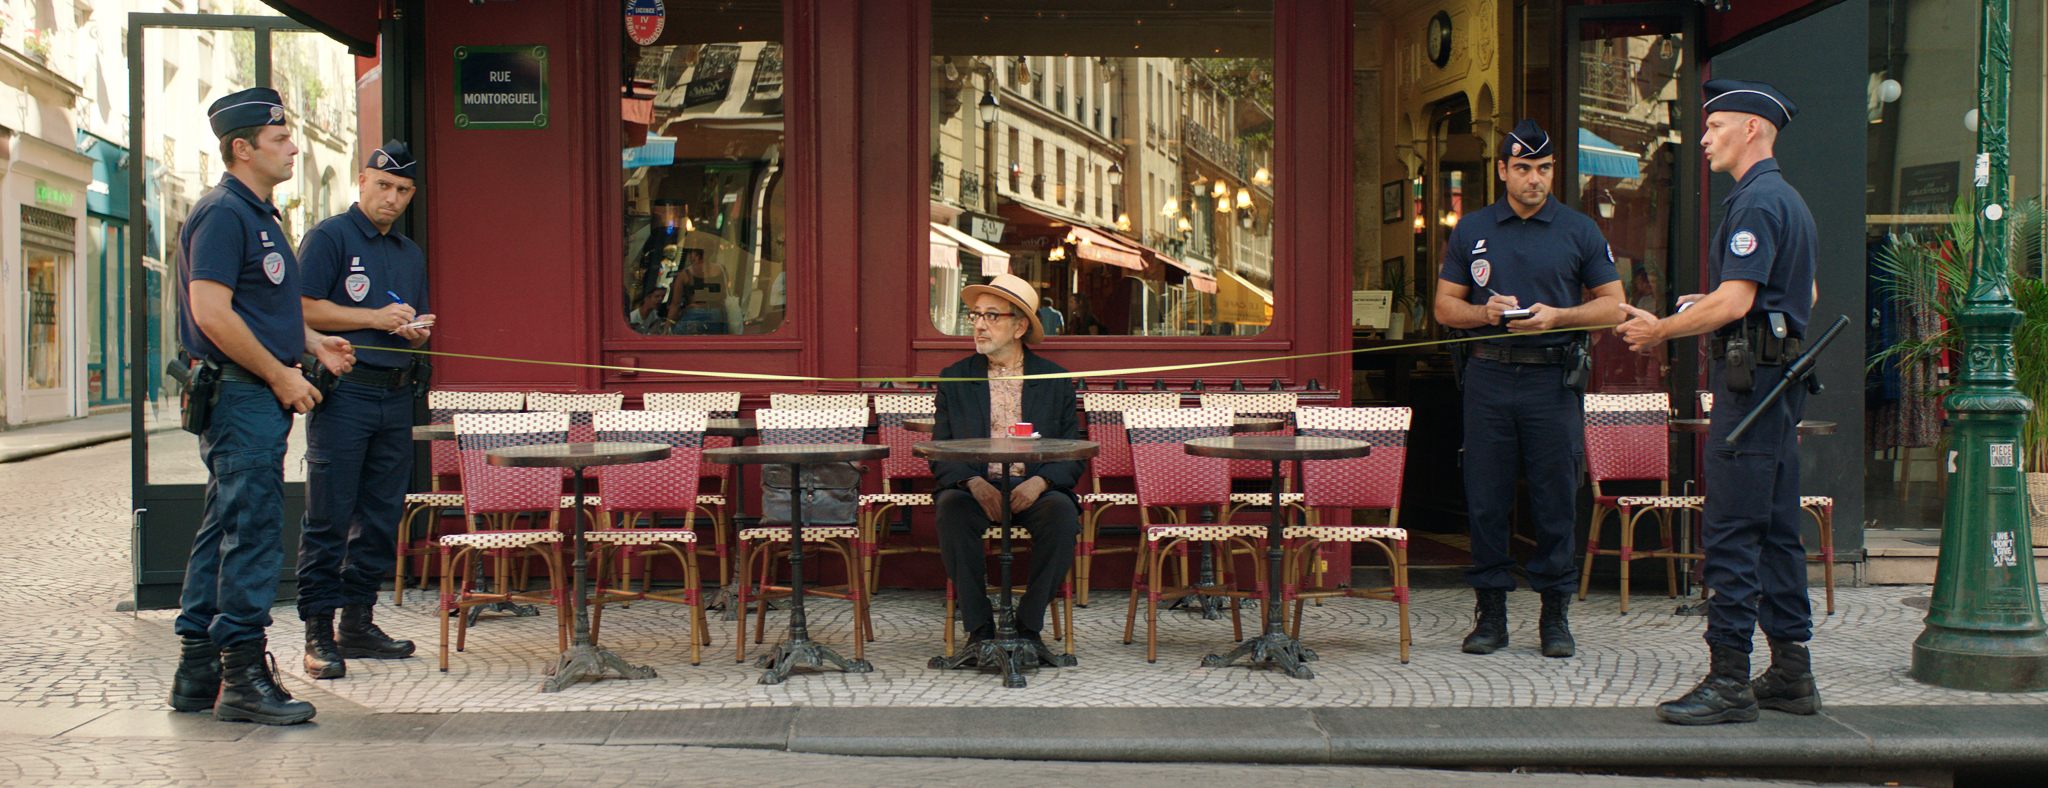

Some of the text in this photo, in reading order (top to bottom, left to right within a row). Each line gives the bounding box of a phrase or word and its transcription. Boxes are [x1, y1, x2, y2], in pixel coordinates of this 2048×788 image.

[640, 16, 649, 24] IV
[489, 71, 512, 82] RUE
[464, 93, 538, 105] MONTORGUEIL
[1991, 445, 2012, 456] PIECE
[1991, 455, 2012, 466] UNIQUE
[1996, 531, 2009, 541] WE
[1993, 540, 2013, 548] DON'T
[1997, 547, 2012, 555] GIVE
